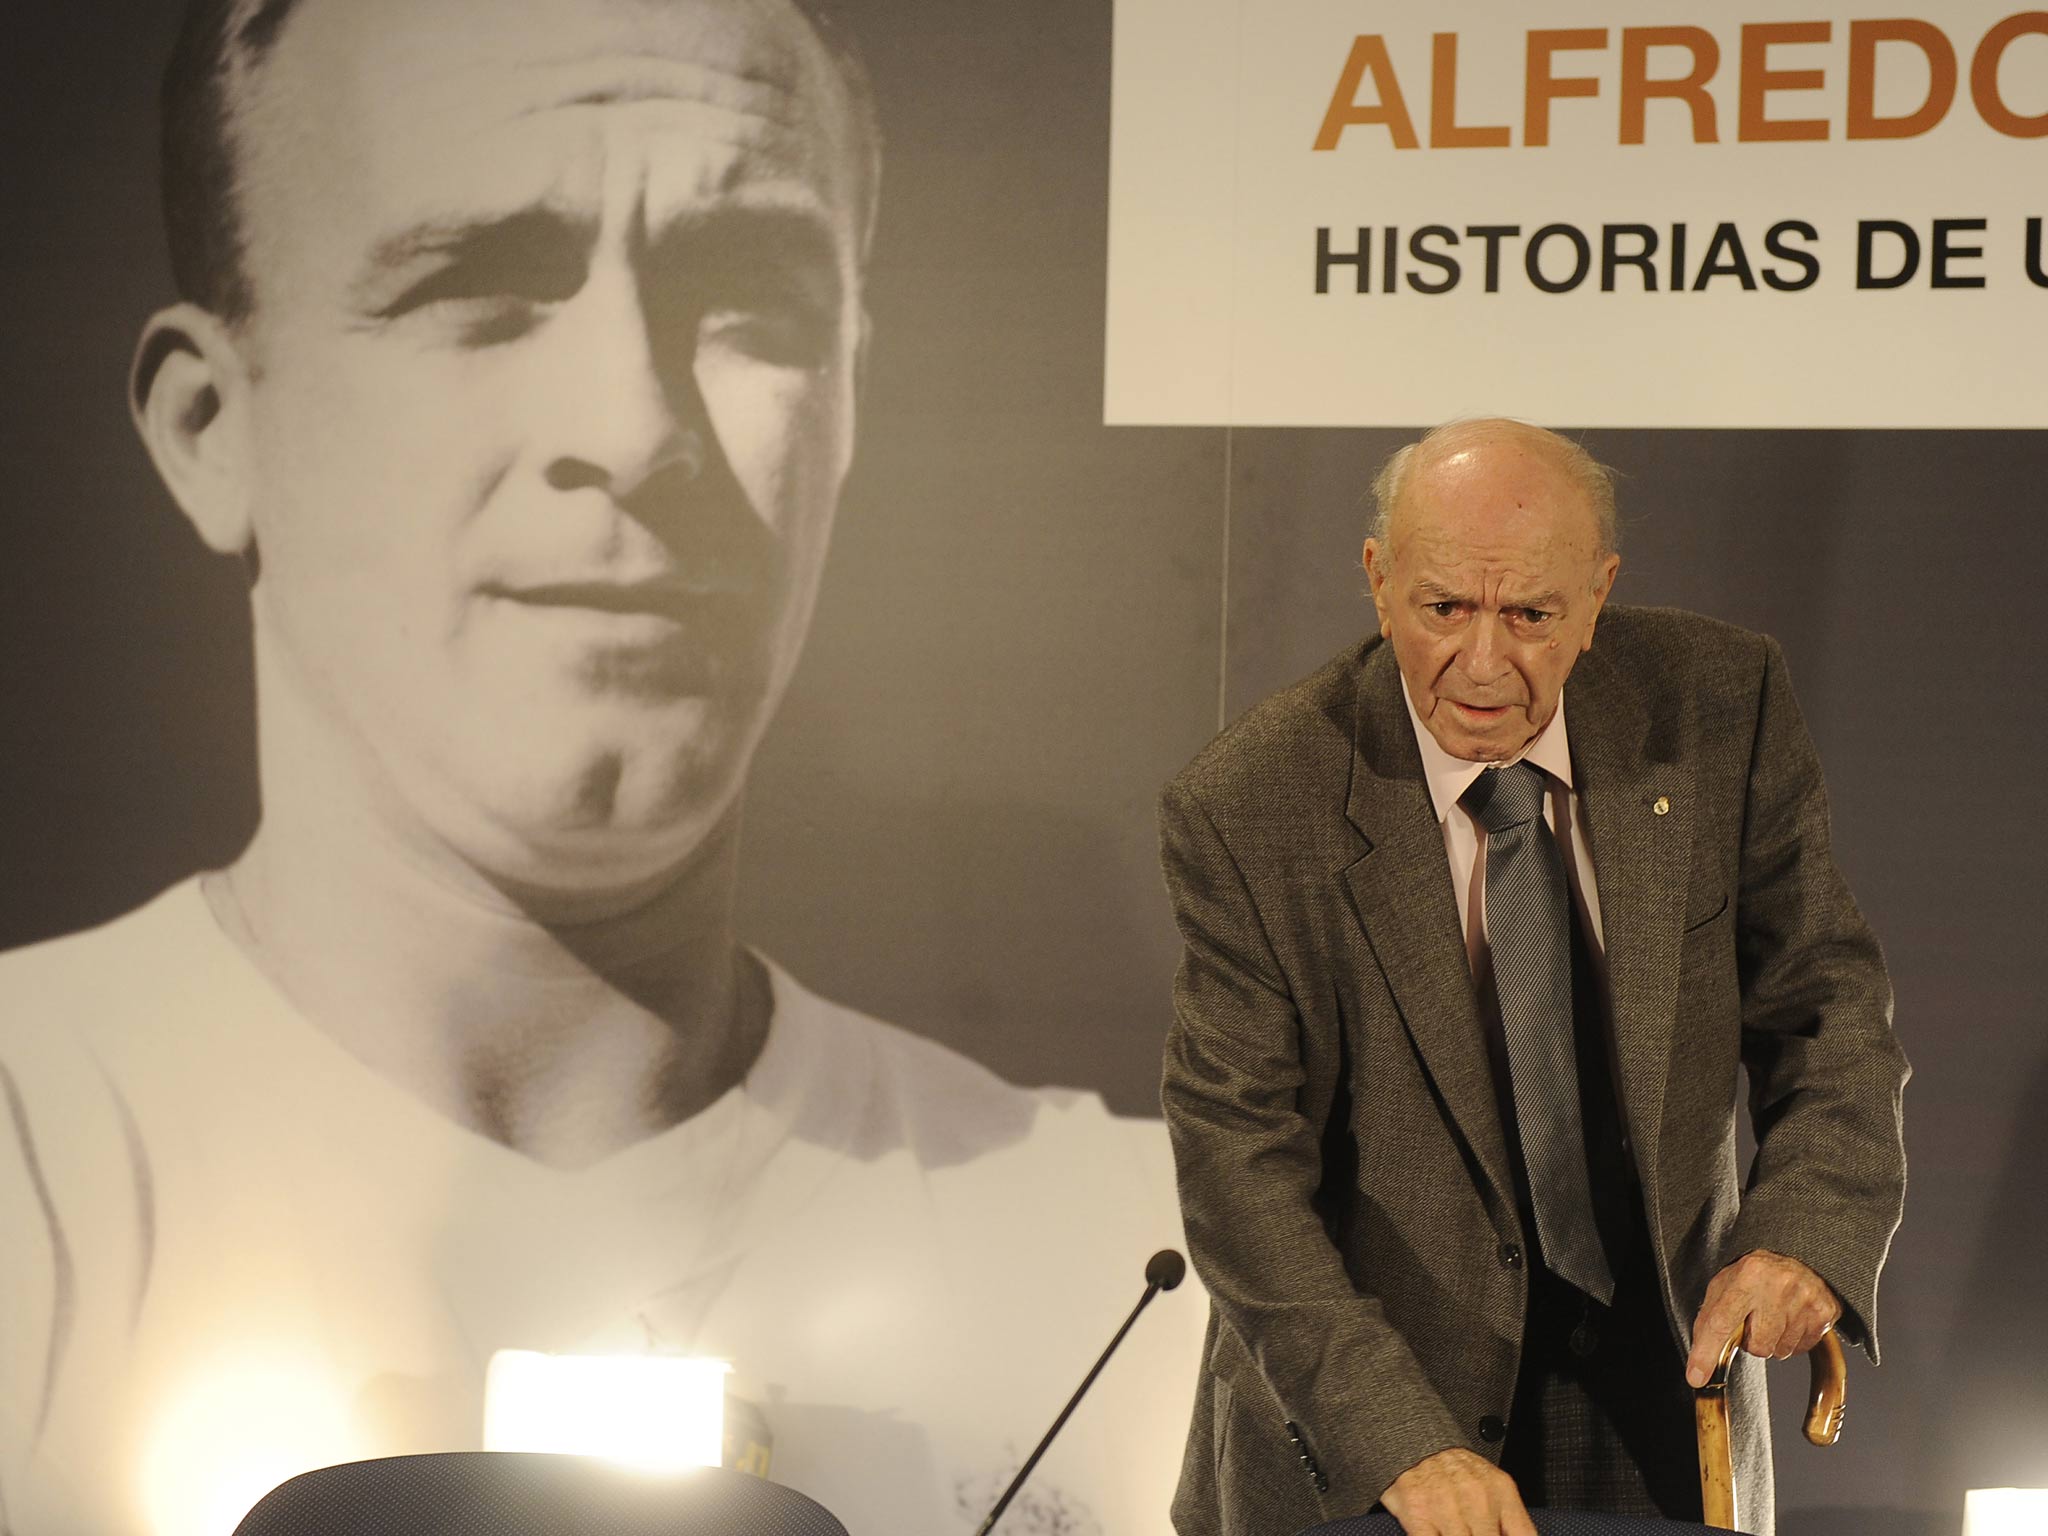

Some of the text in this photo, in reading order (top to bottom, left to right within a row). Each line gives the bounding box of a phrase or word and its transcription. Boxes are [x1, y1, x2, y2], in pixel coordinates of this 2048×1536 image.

[1312, 11, 2048, 151] ALFREDO
[1315, 220, 1821, 294] HISTORIAS
[1856, 218, 1987, 290] DE
